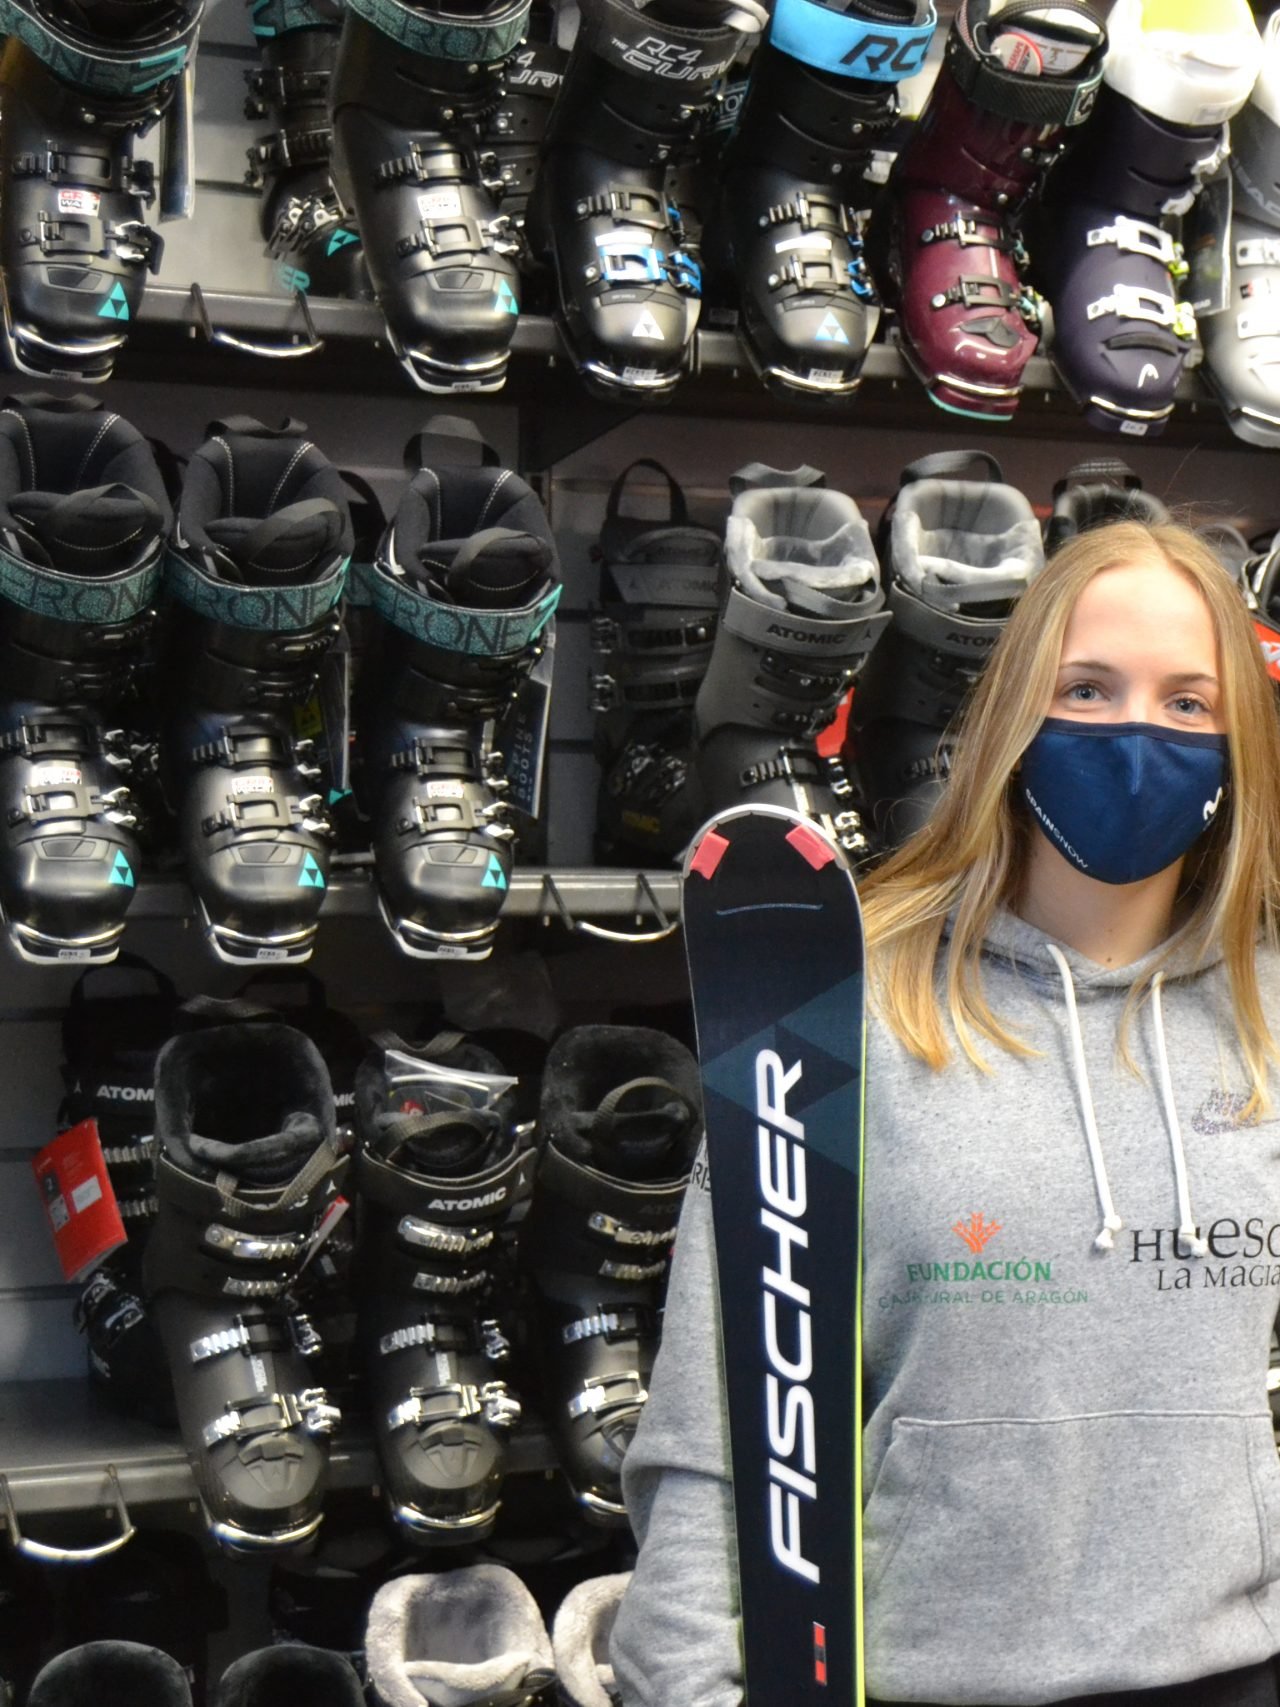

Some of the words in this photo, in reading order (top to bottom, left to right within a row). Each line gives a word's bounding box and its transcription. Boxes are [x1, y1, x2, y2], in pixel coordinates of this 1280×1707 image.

[636, 36, 702, 65] RC4
[767, 623, 848, 645] ATOMIC
[518, 732, 533, 799] BOOTS
[428, 1186, 507, 1211] ATOMIC
[906, 1256, 1055, 1283] FUNDACIÓN
[981, 1289, 1006, 1304] DE
[1013, 1284, 1089, 1305] ARAGÓN
[755, 1048, 820, 1584] FISCHER
